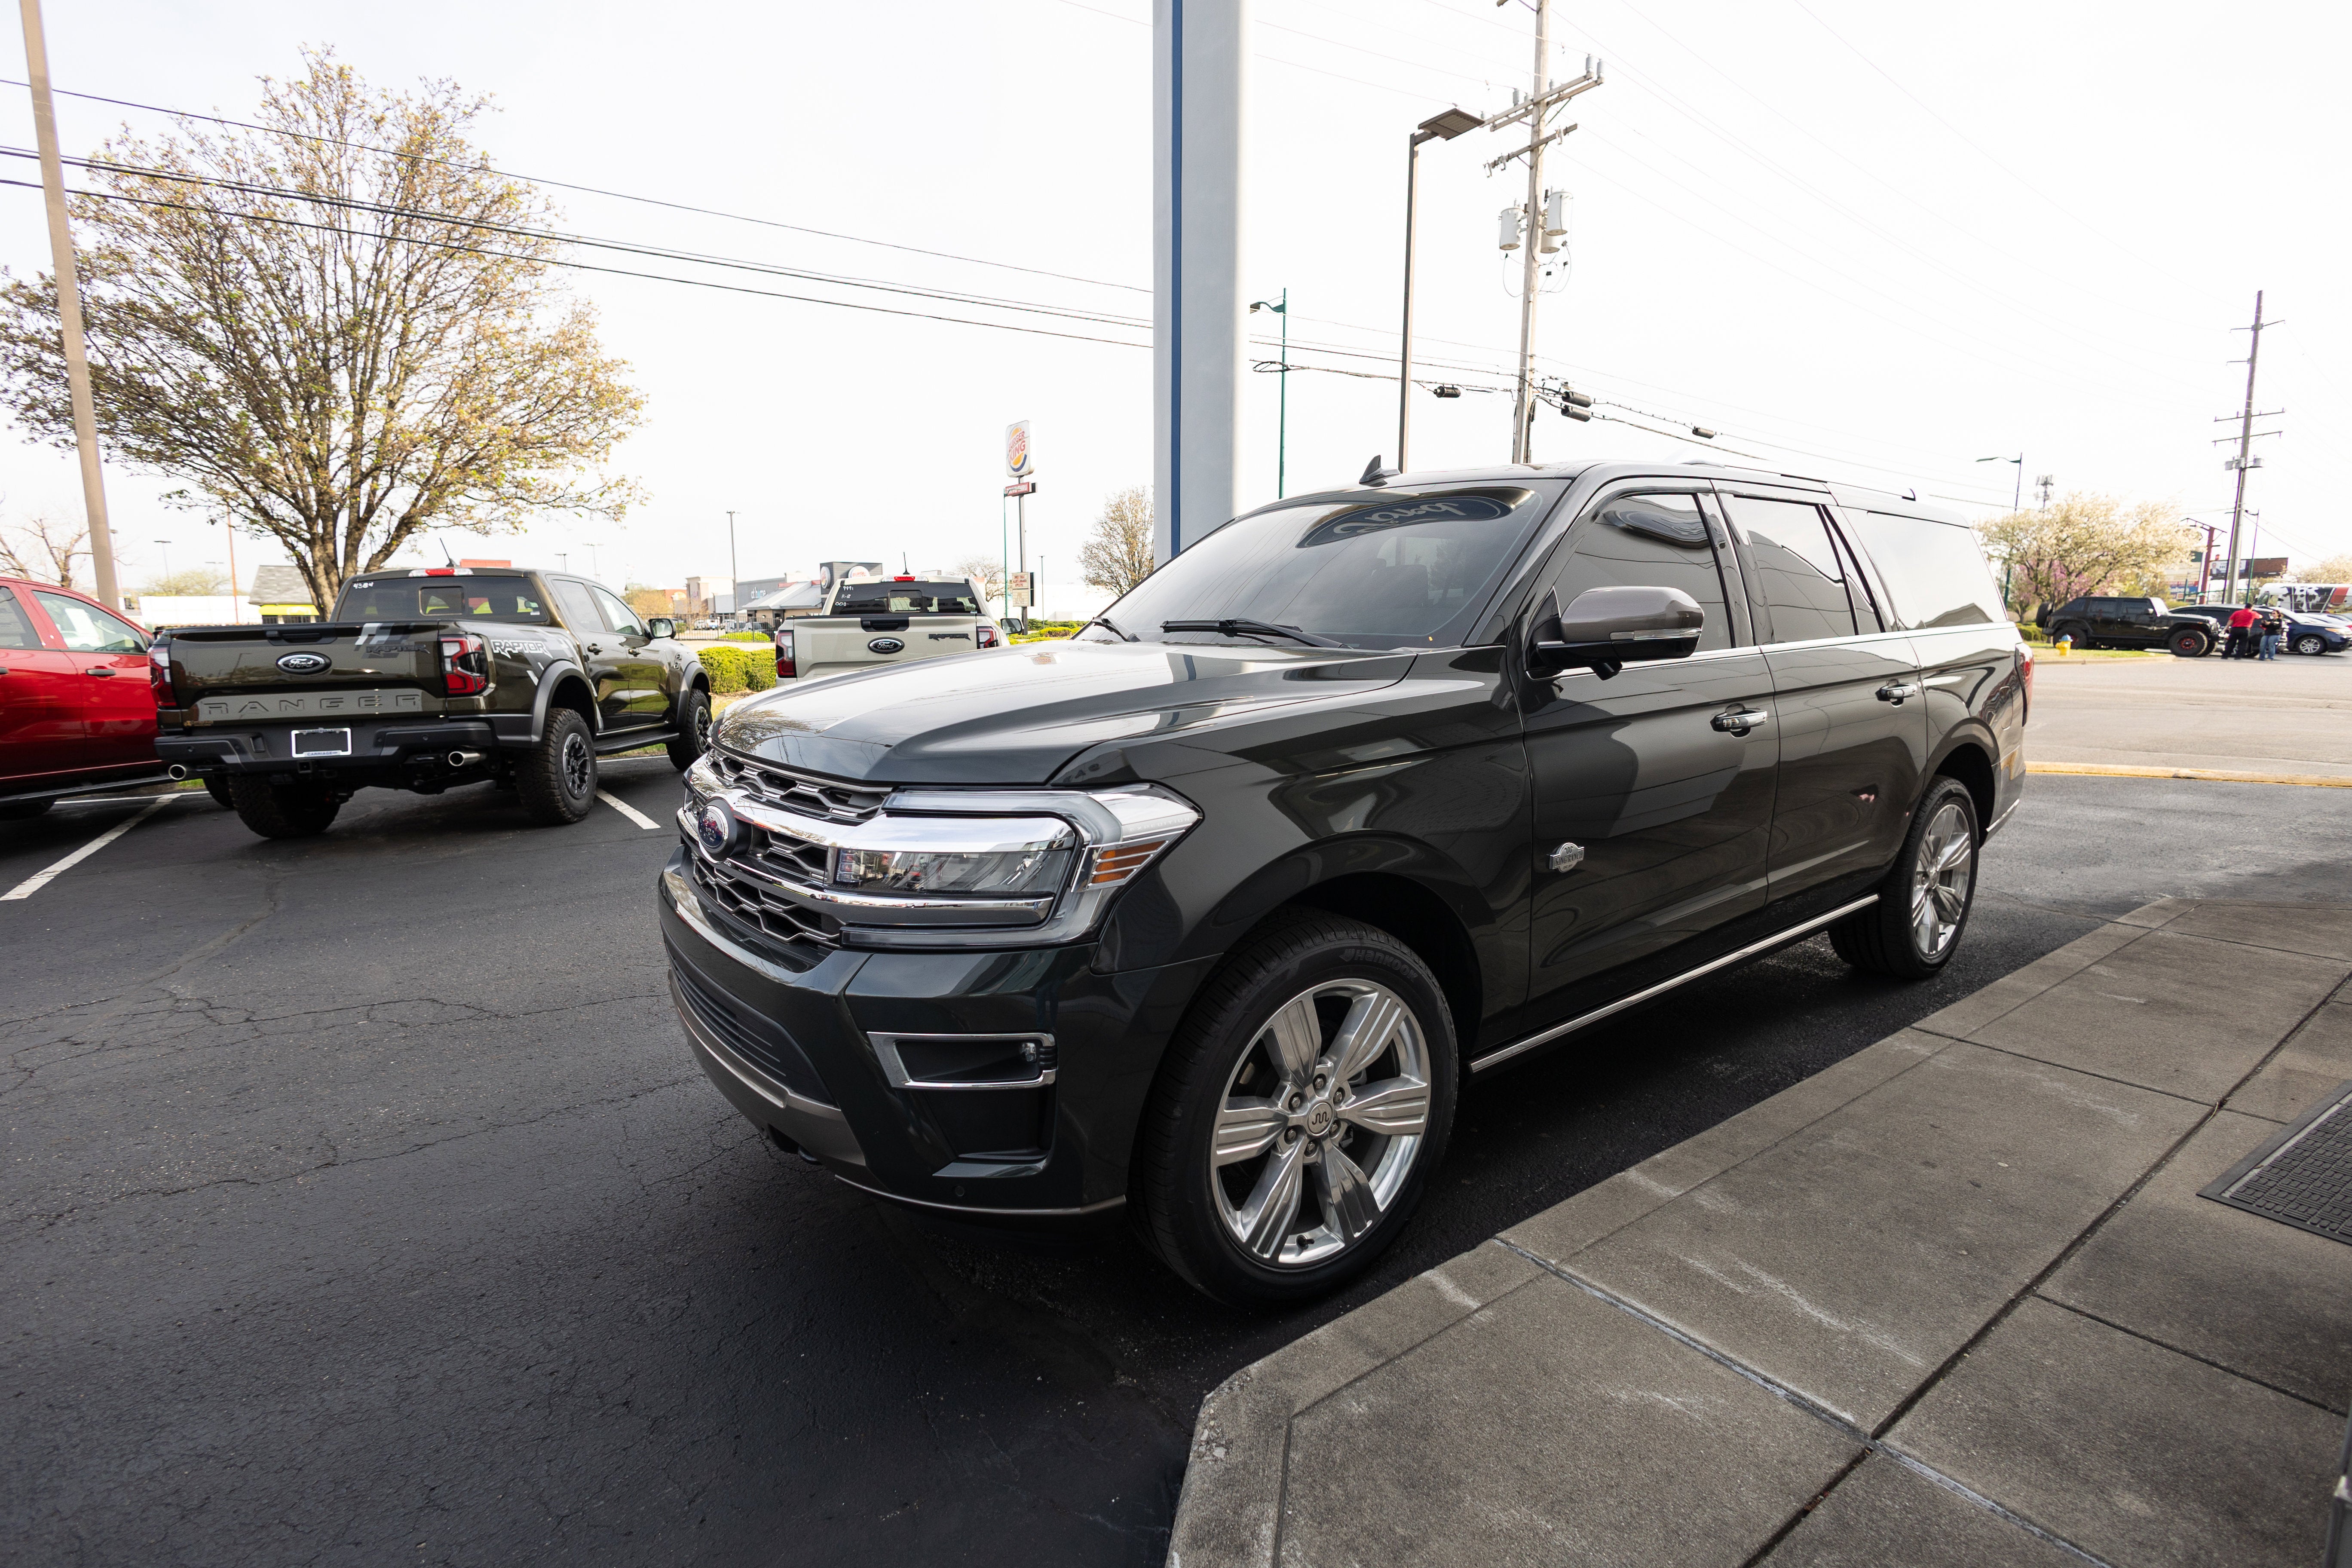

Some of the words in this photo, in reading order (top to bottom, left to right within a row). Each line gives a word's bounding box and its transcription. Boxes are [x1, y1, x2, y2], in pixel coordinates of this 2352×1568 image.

[1009, 431, 1025, 452] BURGER
[1009, 440, 1026, 462] KING
[928, 633, 971, 641] RAPTOR
[366, 645, 430, 658] RAPTOR
[490, 640, 554, 659] RAPTOR
[289, 658, 313, 668] Ford
[203, 694, 420, 715] RANGER
[1128, 817, 1190, 832] EXPEDITION
[1555, 856, 1567, 866] KING
[1568, 850, 1583, 863] RANCH
